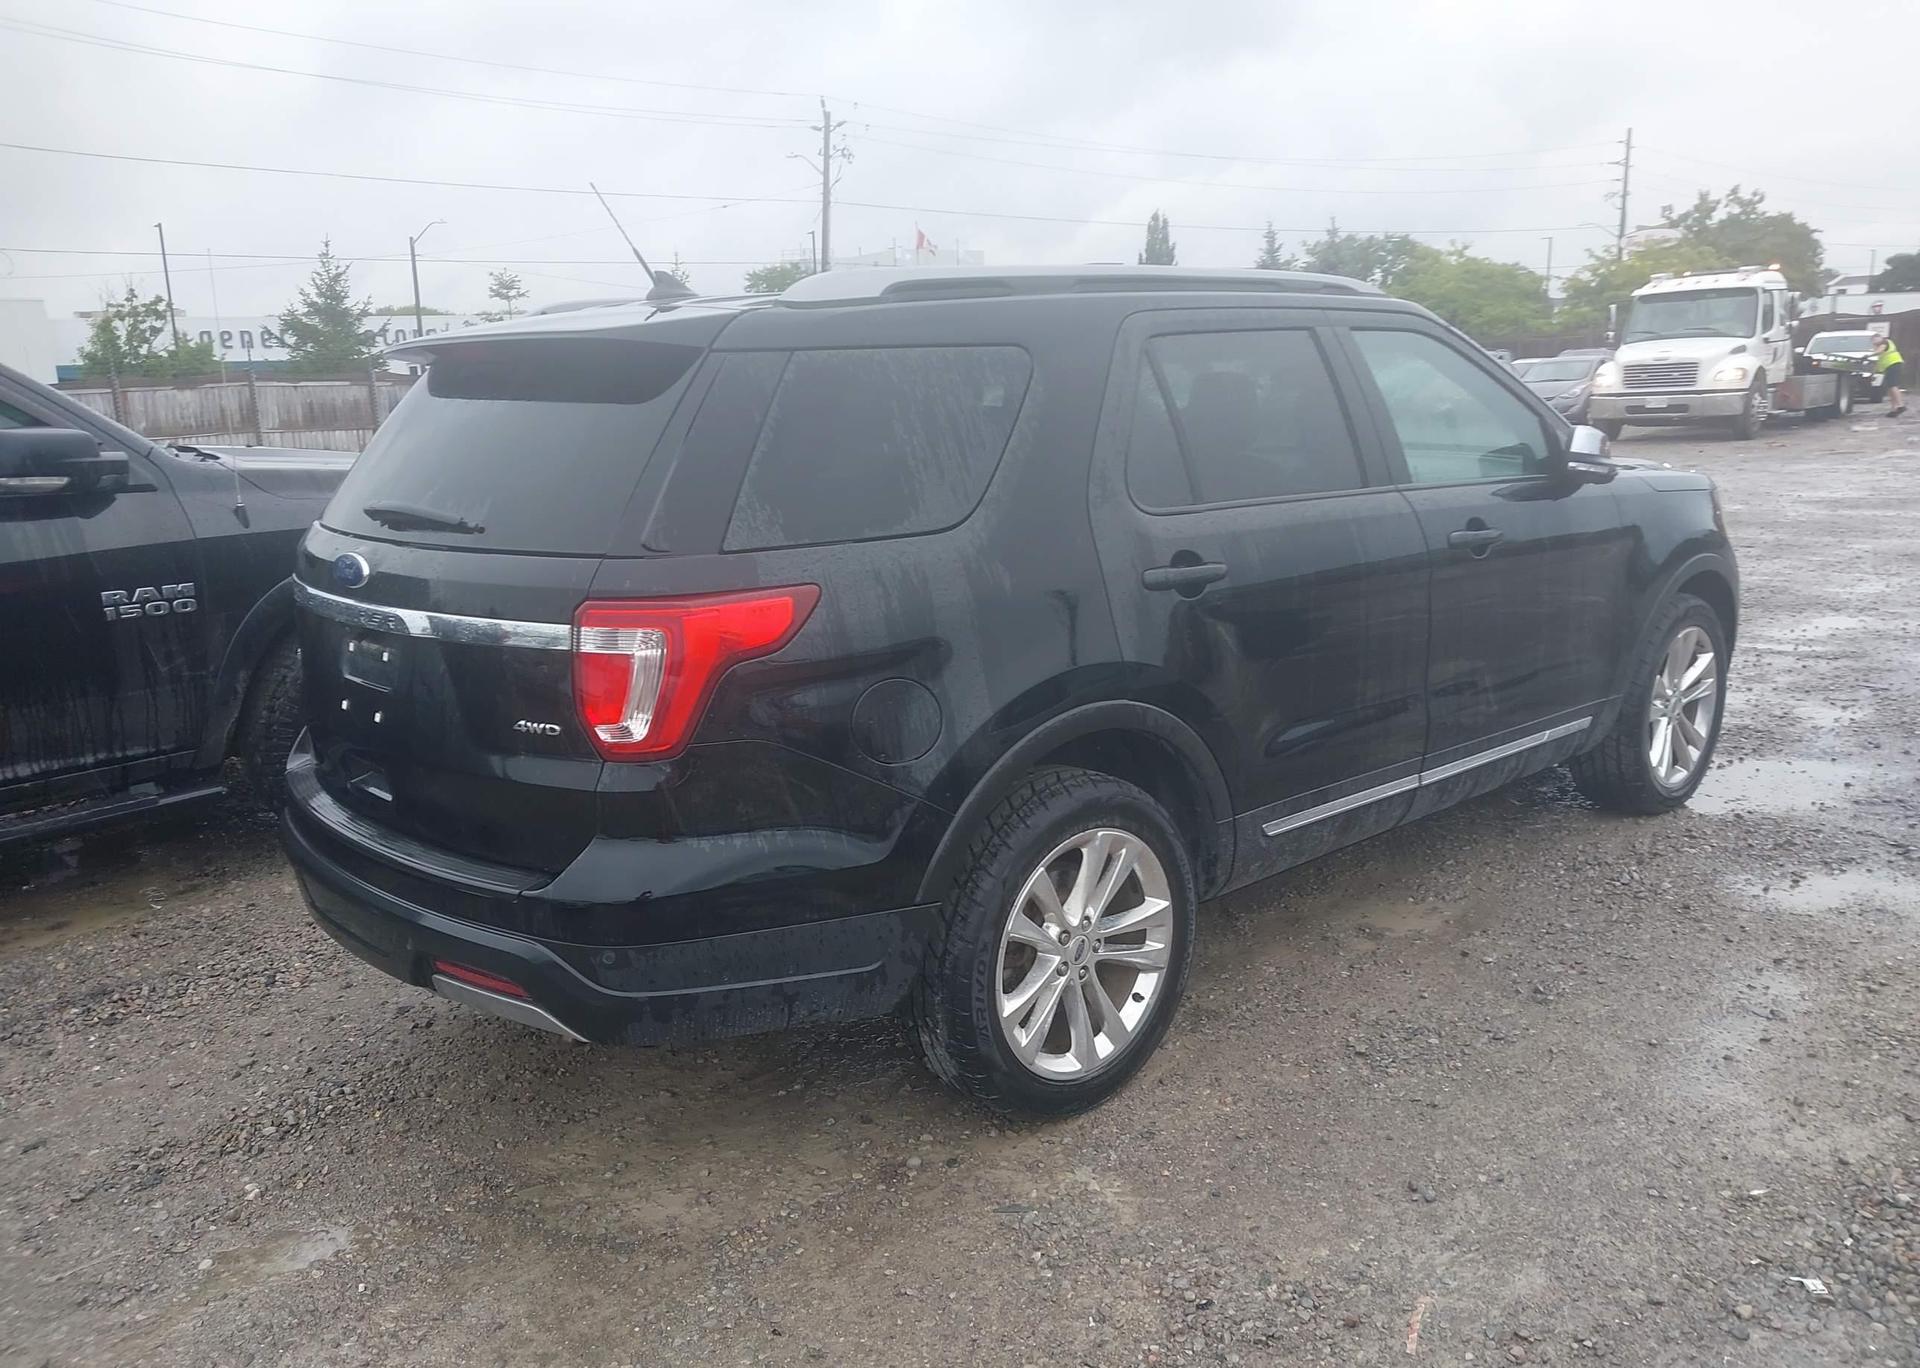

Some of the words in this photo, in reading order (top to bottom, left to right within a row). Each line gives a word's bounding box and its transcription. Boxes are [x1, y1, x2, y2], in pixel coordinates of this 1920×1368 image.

[101, 582, 195, 606] RAM
[103, 598, 197, 621] 1500
[513, 720, 560, 736] 4WD
